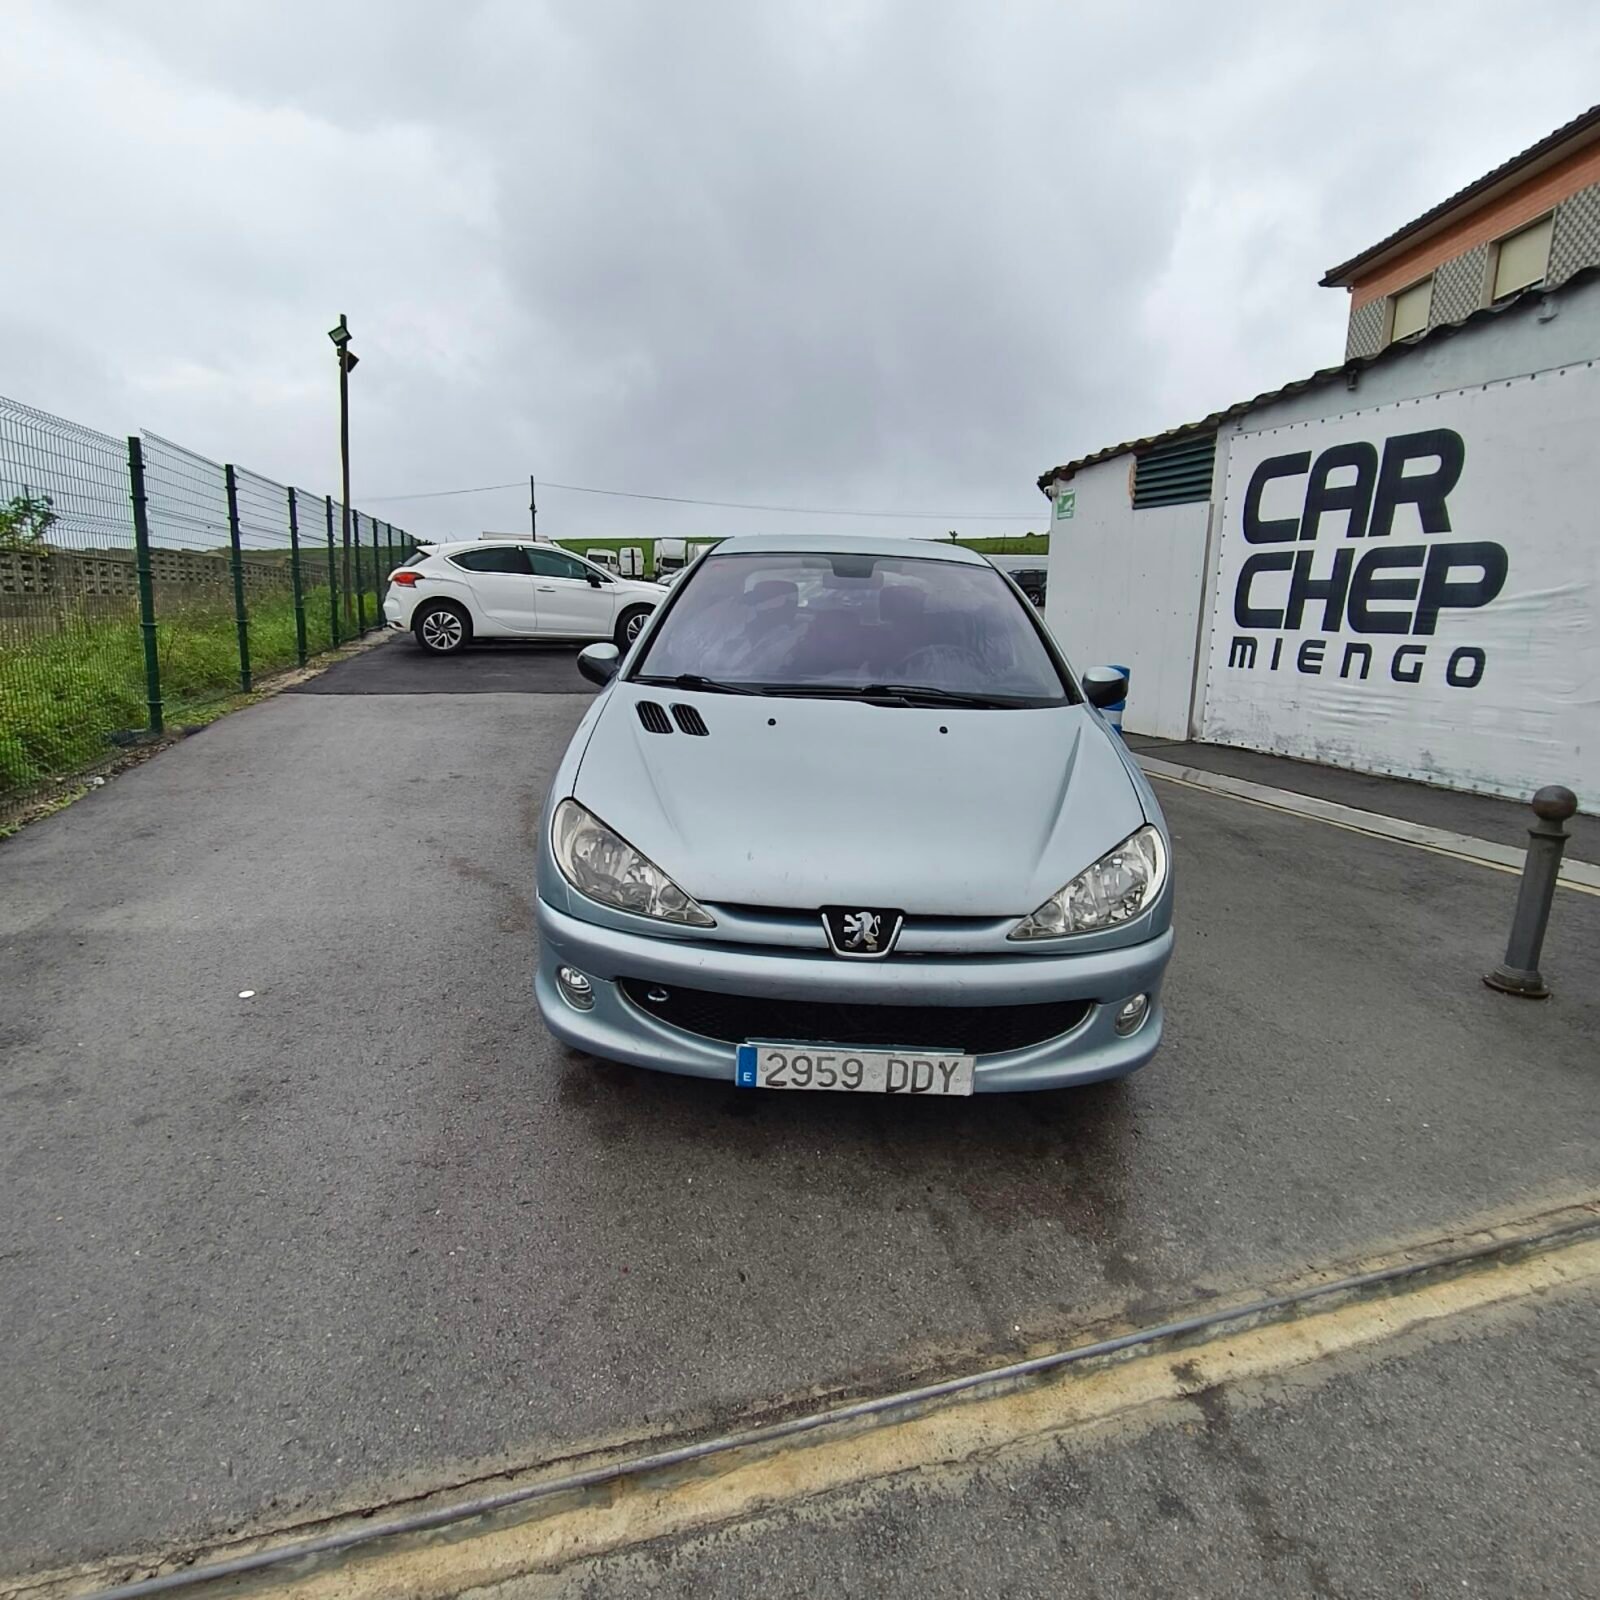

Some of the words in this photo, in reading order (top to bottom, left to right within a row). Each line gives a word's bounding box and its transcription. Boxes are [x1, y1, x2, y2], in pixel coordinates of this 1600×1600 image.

[1244, 428, 1465, 544] CAR
[1235, 541, 1508, 635] CHEP
[1228, 636, 1486, 687] MIENGO
[743, 1072, 752, 1082] E
[765, 1053, 864, 1090] 2959
[886, 1059, 960, 1093] DDY
